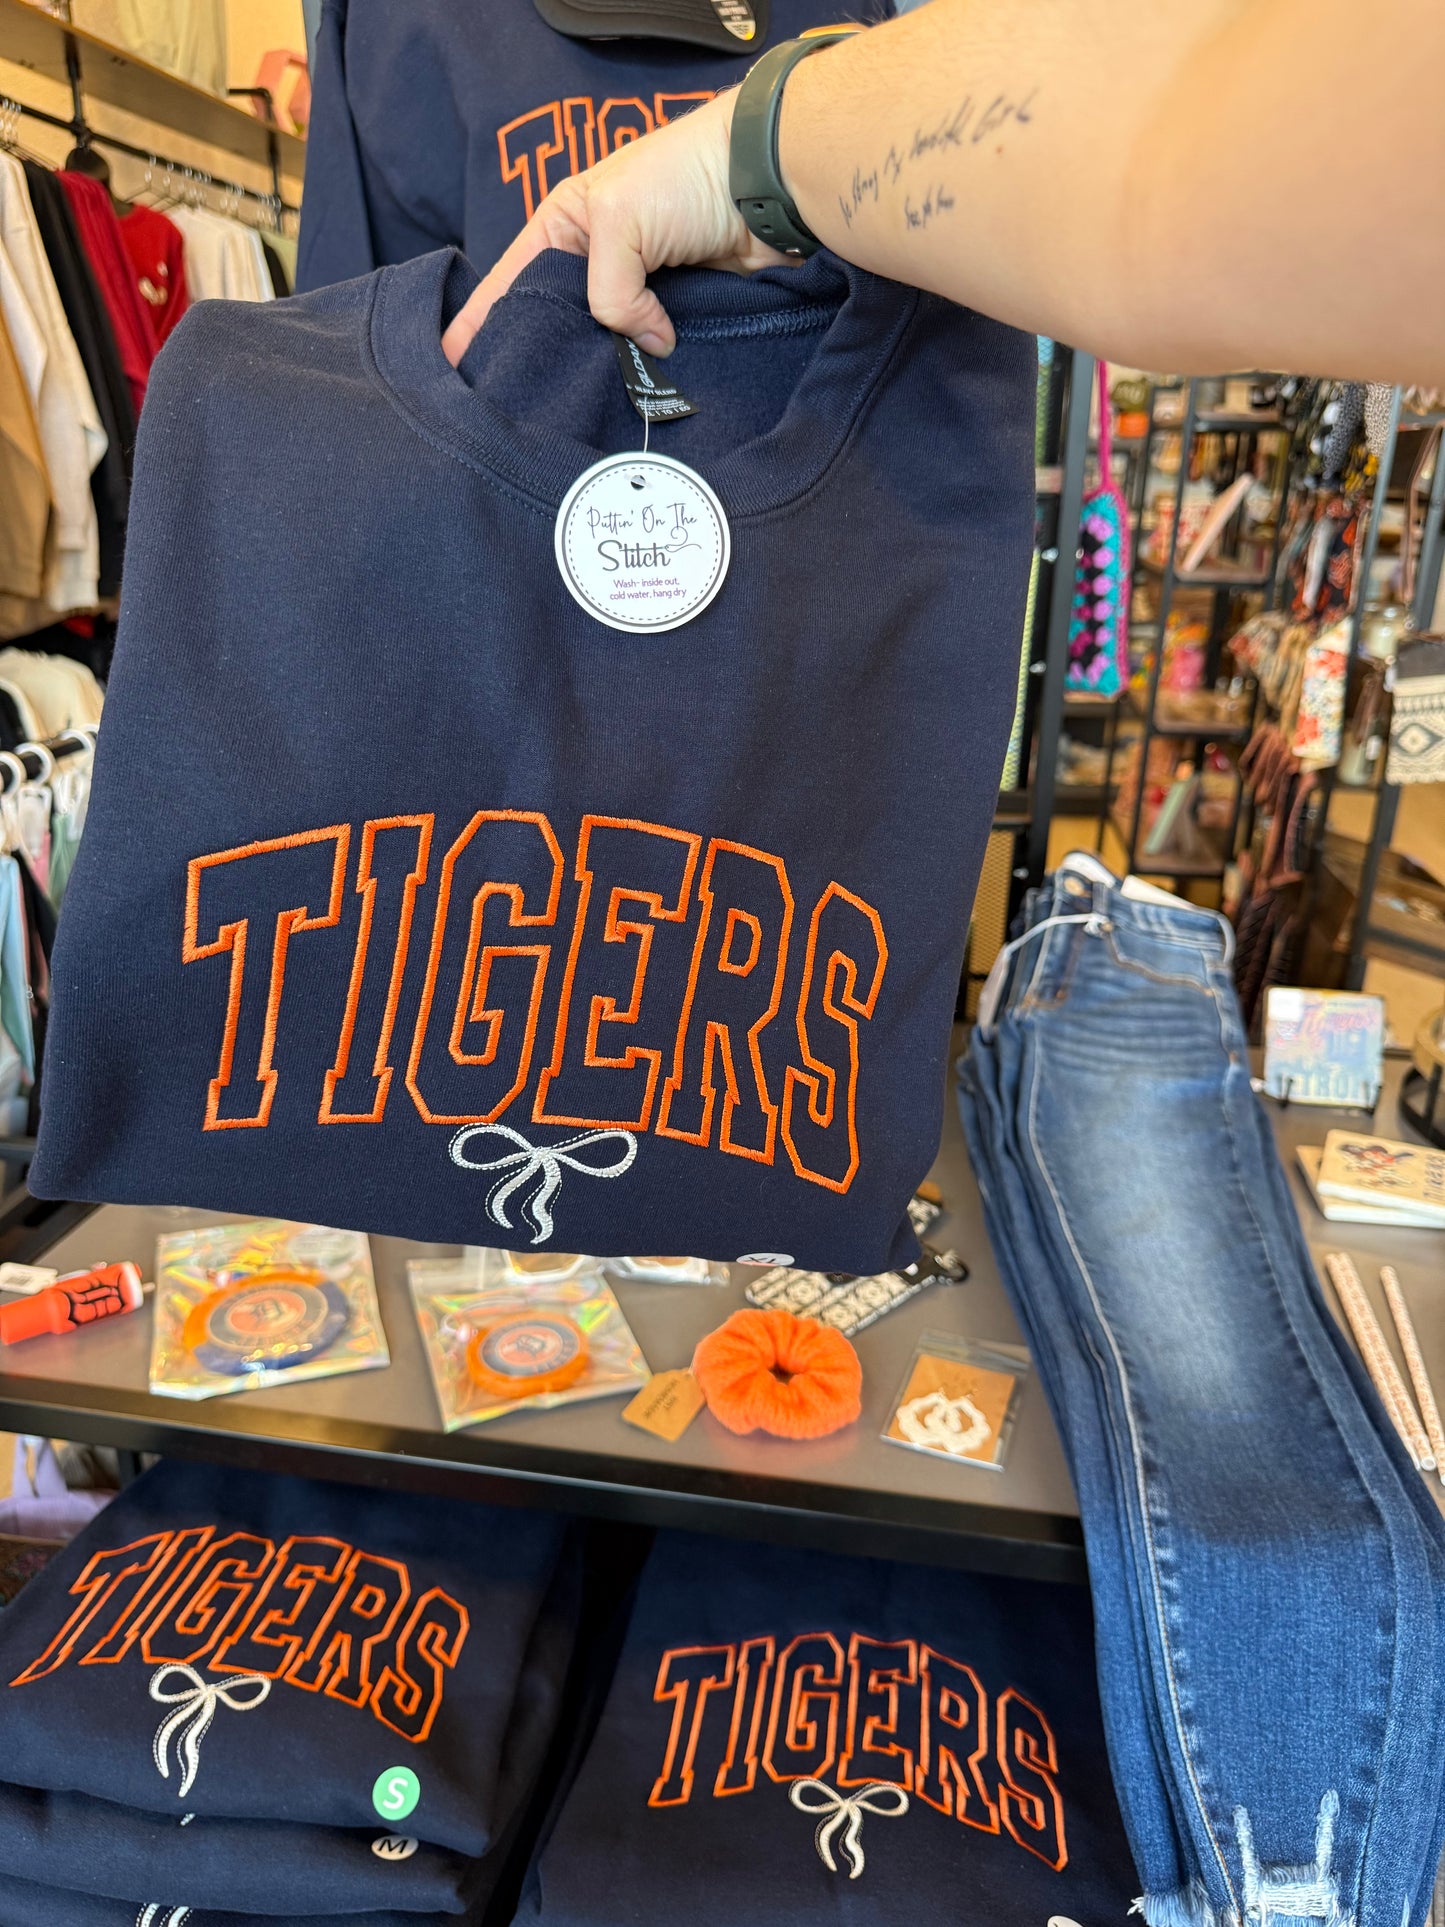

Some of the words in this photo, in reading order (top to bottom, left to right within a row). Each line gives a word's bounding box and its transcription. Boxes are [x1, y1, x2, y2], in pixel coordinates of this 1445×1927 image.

[642, 504, 666, 533] On
[666, 503, 697, 530] The
[597, 539, 671, 572] Stitch
[609, 592, 626, 601] cold
[653, 589, 673, 599] hang
[673, 587, 687, 598] dry
[641, 578, 664, 587] inside
[182, 809, 889, 1195] TIGERS
[9, 1524, 470, 1743] TIGERS
[648, 1631, 1068, 1872] TIGERS
[382, 1776, 410, 1811] S
[377, 1838, 409, 1854] M
